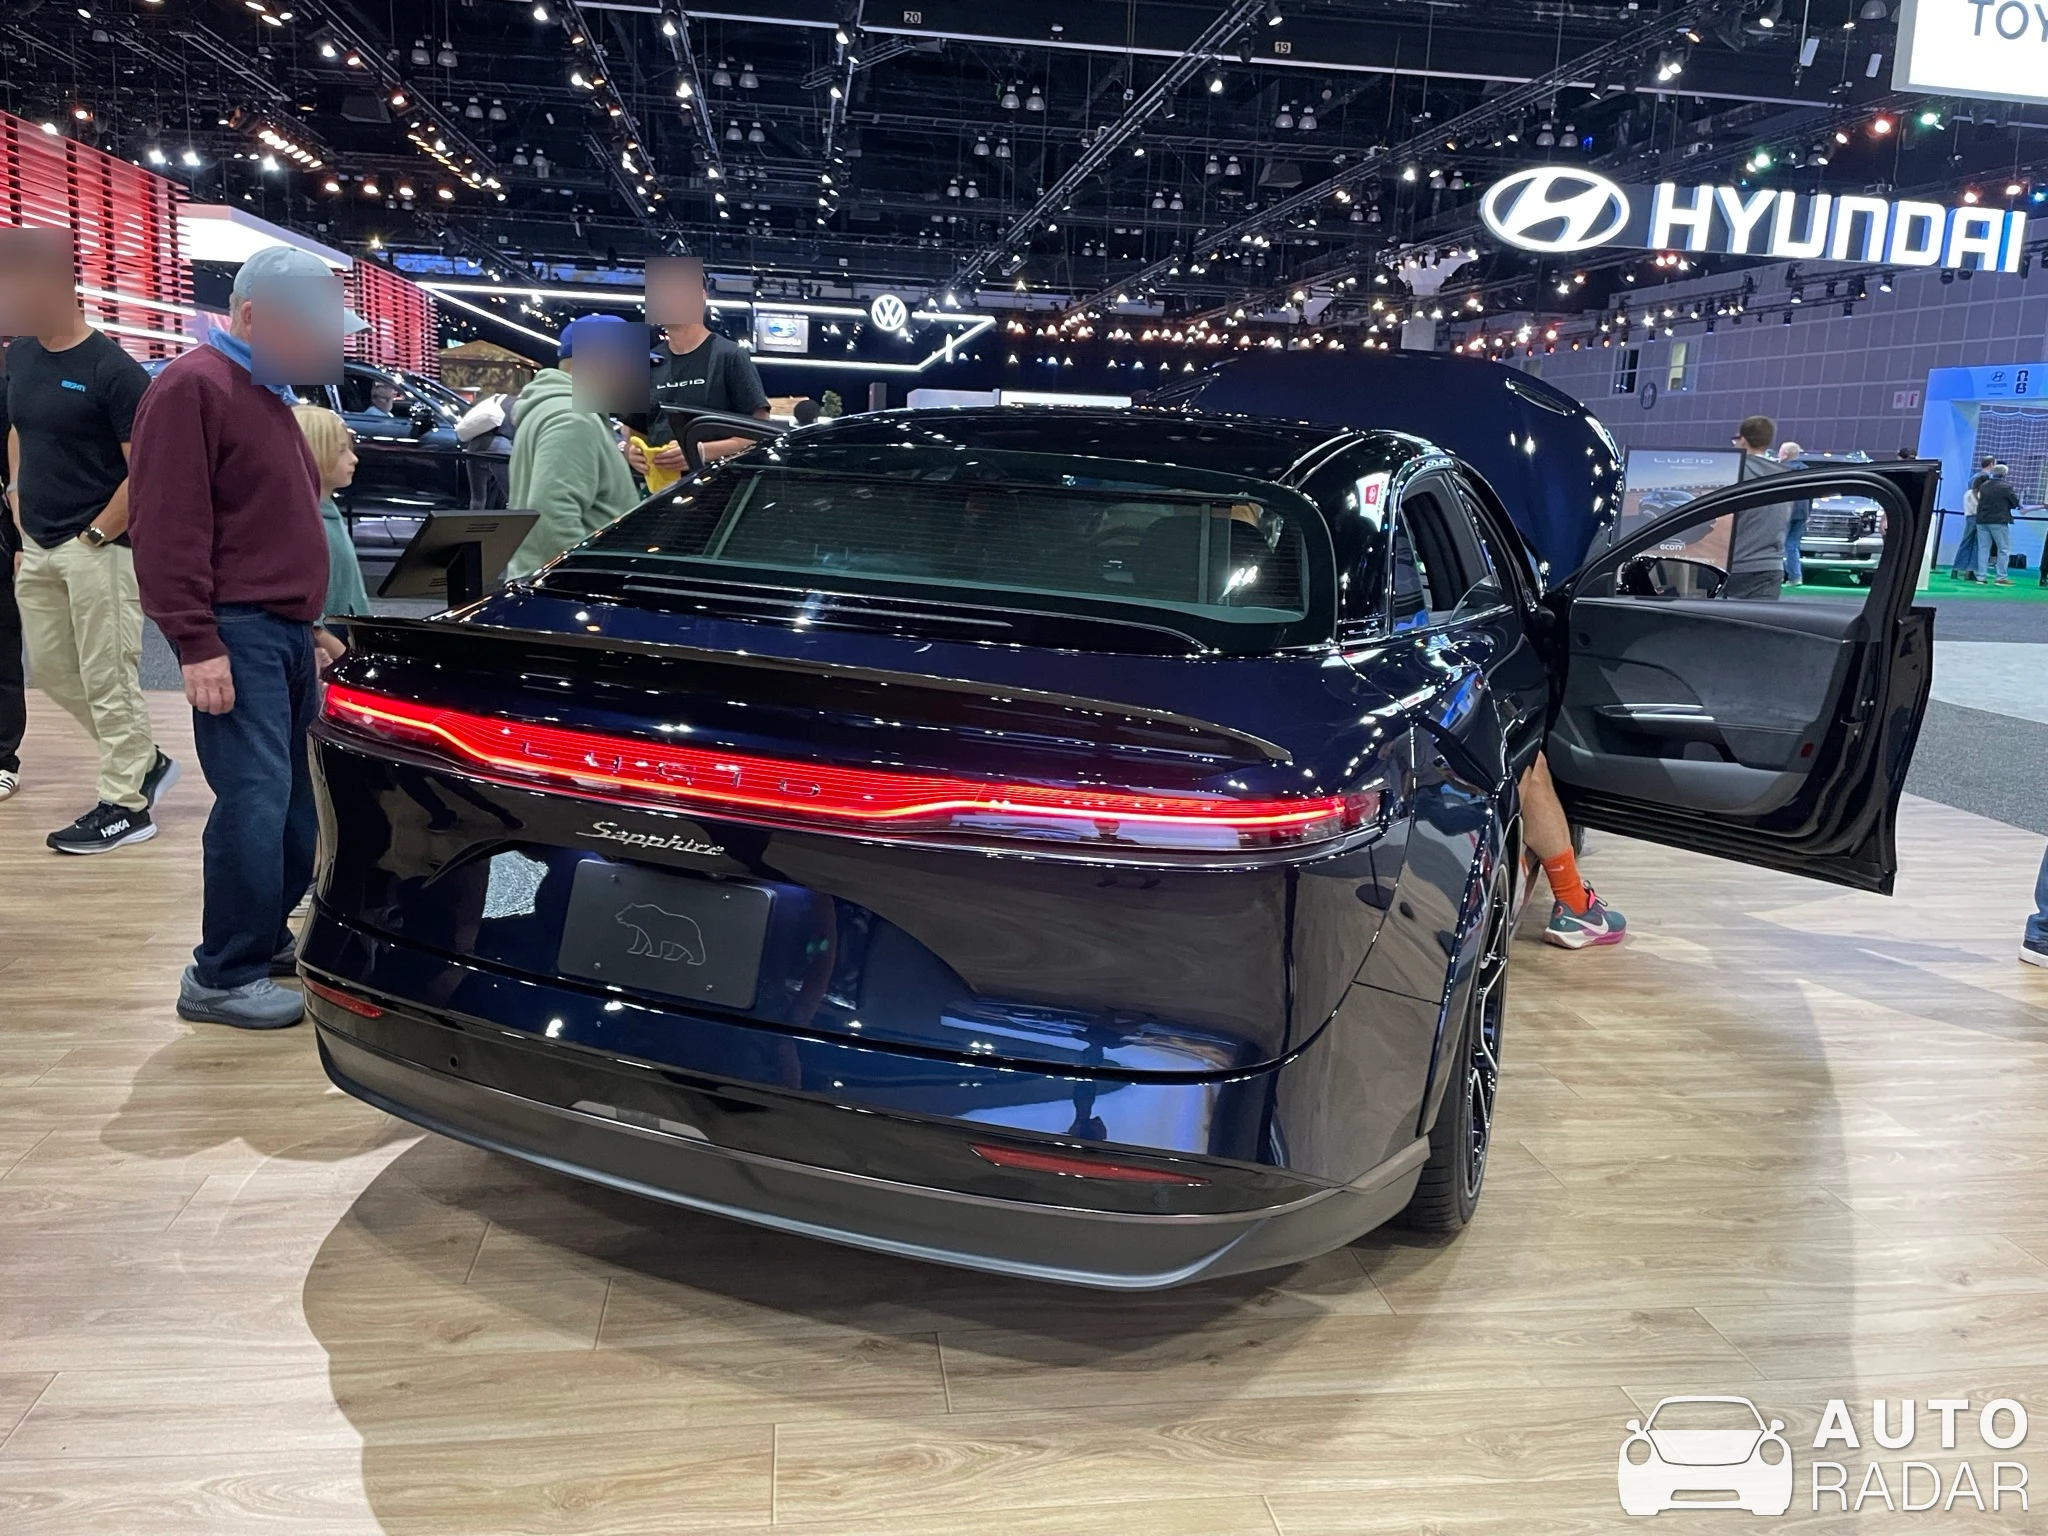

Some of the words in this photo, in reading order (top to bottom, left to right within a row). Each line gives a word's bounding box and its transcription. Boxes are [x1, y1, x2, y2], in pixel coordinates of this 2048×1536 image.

[905, 12, 920, 23] 20
[1276, 43, 1289, 53] 19
[1649, 182, 2027, 273] HYUNDAI
[656, 378, 706, 390] LUCID
[100, 818, 130, 838] HOKA
[575, 821, 725, 856] Sapphire
